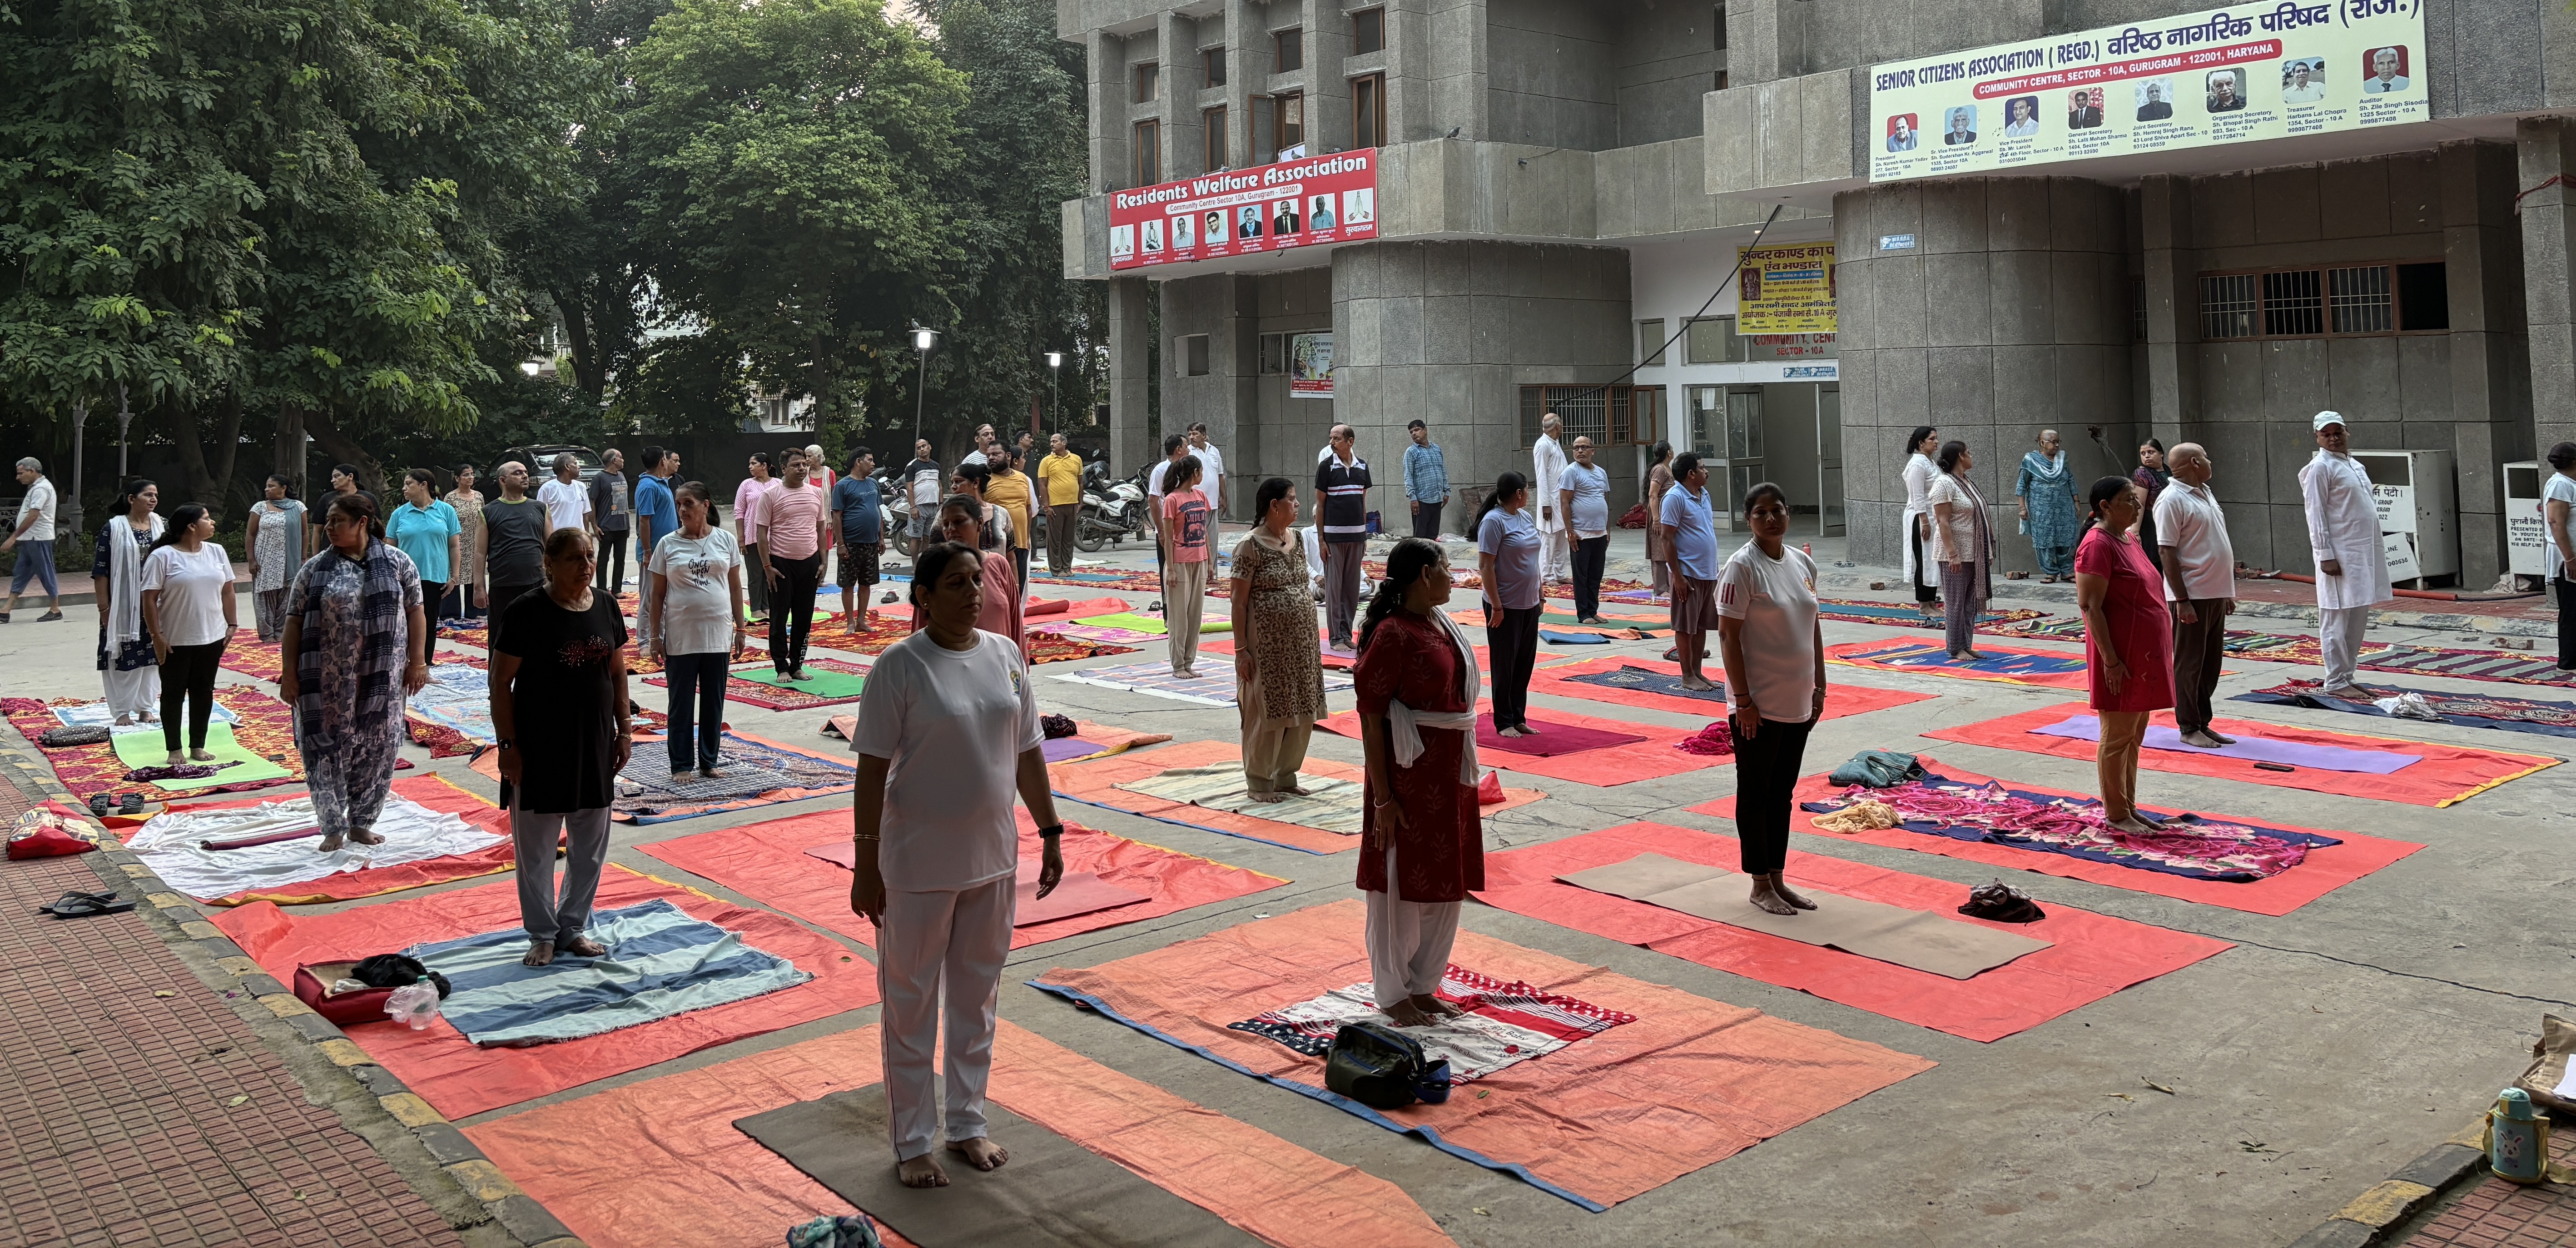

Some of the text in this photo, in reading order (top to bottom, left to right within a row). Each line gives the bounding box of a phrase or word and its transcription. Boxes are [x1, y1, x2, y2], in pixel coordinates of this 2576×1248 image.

[2107, 27, 2163, 55] वरिष्ठ
[2166, 12, 2253, 46] नागरिक
[2259, 2, 2331, 32] परिषद
[1876, 69, 1916, 91] SENIOR
[1919, 61, 1965, 84] CITIZENS
[1969, 48, 2043, 79] ASSOCIATION
[1979, 79, 2028, 94] COMMUNITY
[2030, 74, 2065, 86] CENTRE,
[2067, 69, 2101, 81] SECTOR
[2109, 65, 2127, 76] 10A,
[2129, 57, 2181, 72] GURUGRAM
[2189, 51, 2224, 64] 122001,
[2227, 44, 2273, 59] HARYANA
[1117, 156, 1367, 210] Residents Welfare Association
[1170, 201, 1198, 211] Community
[1199, 197, 1216, 207] Centre
[1248, 190, 1275, 200] Gurugram
[1280, 185, 1298, 194] 122001
[1777, 347, 1803, 355] SECTOR
[2510, 517, 2528, 526] पुरानी
